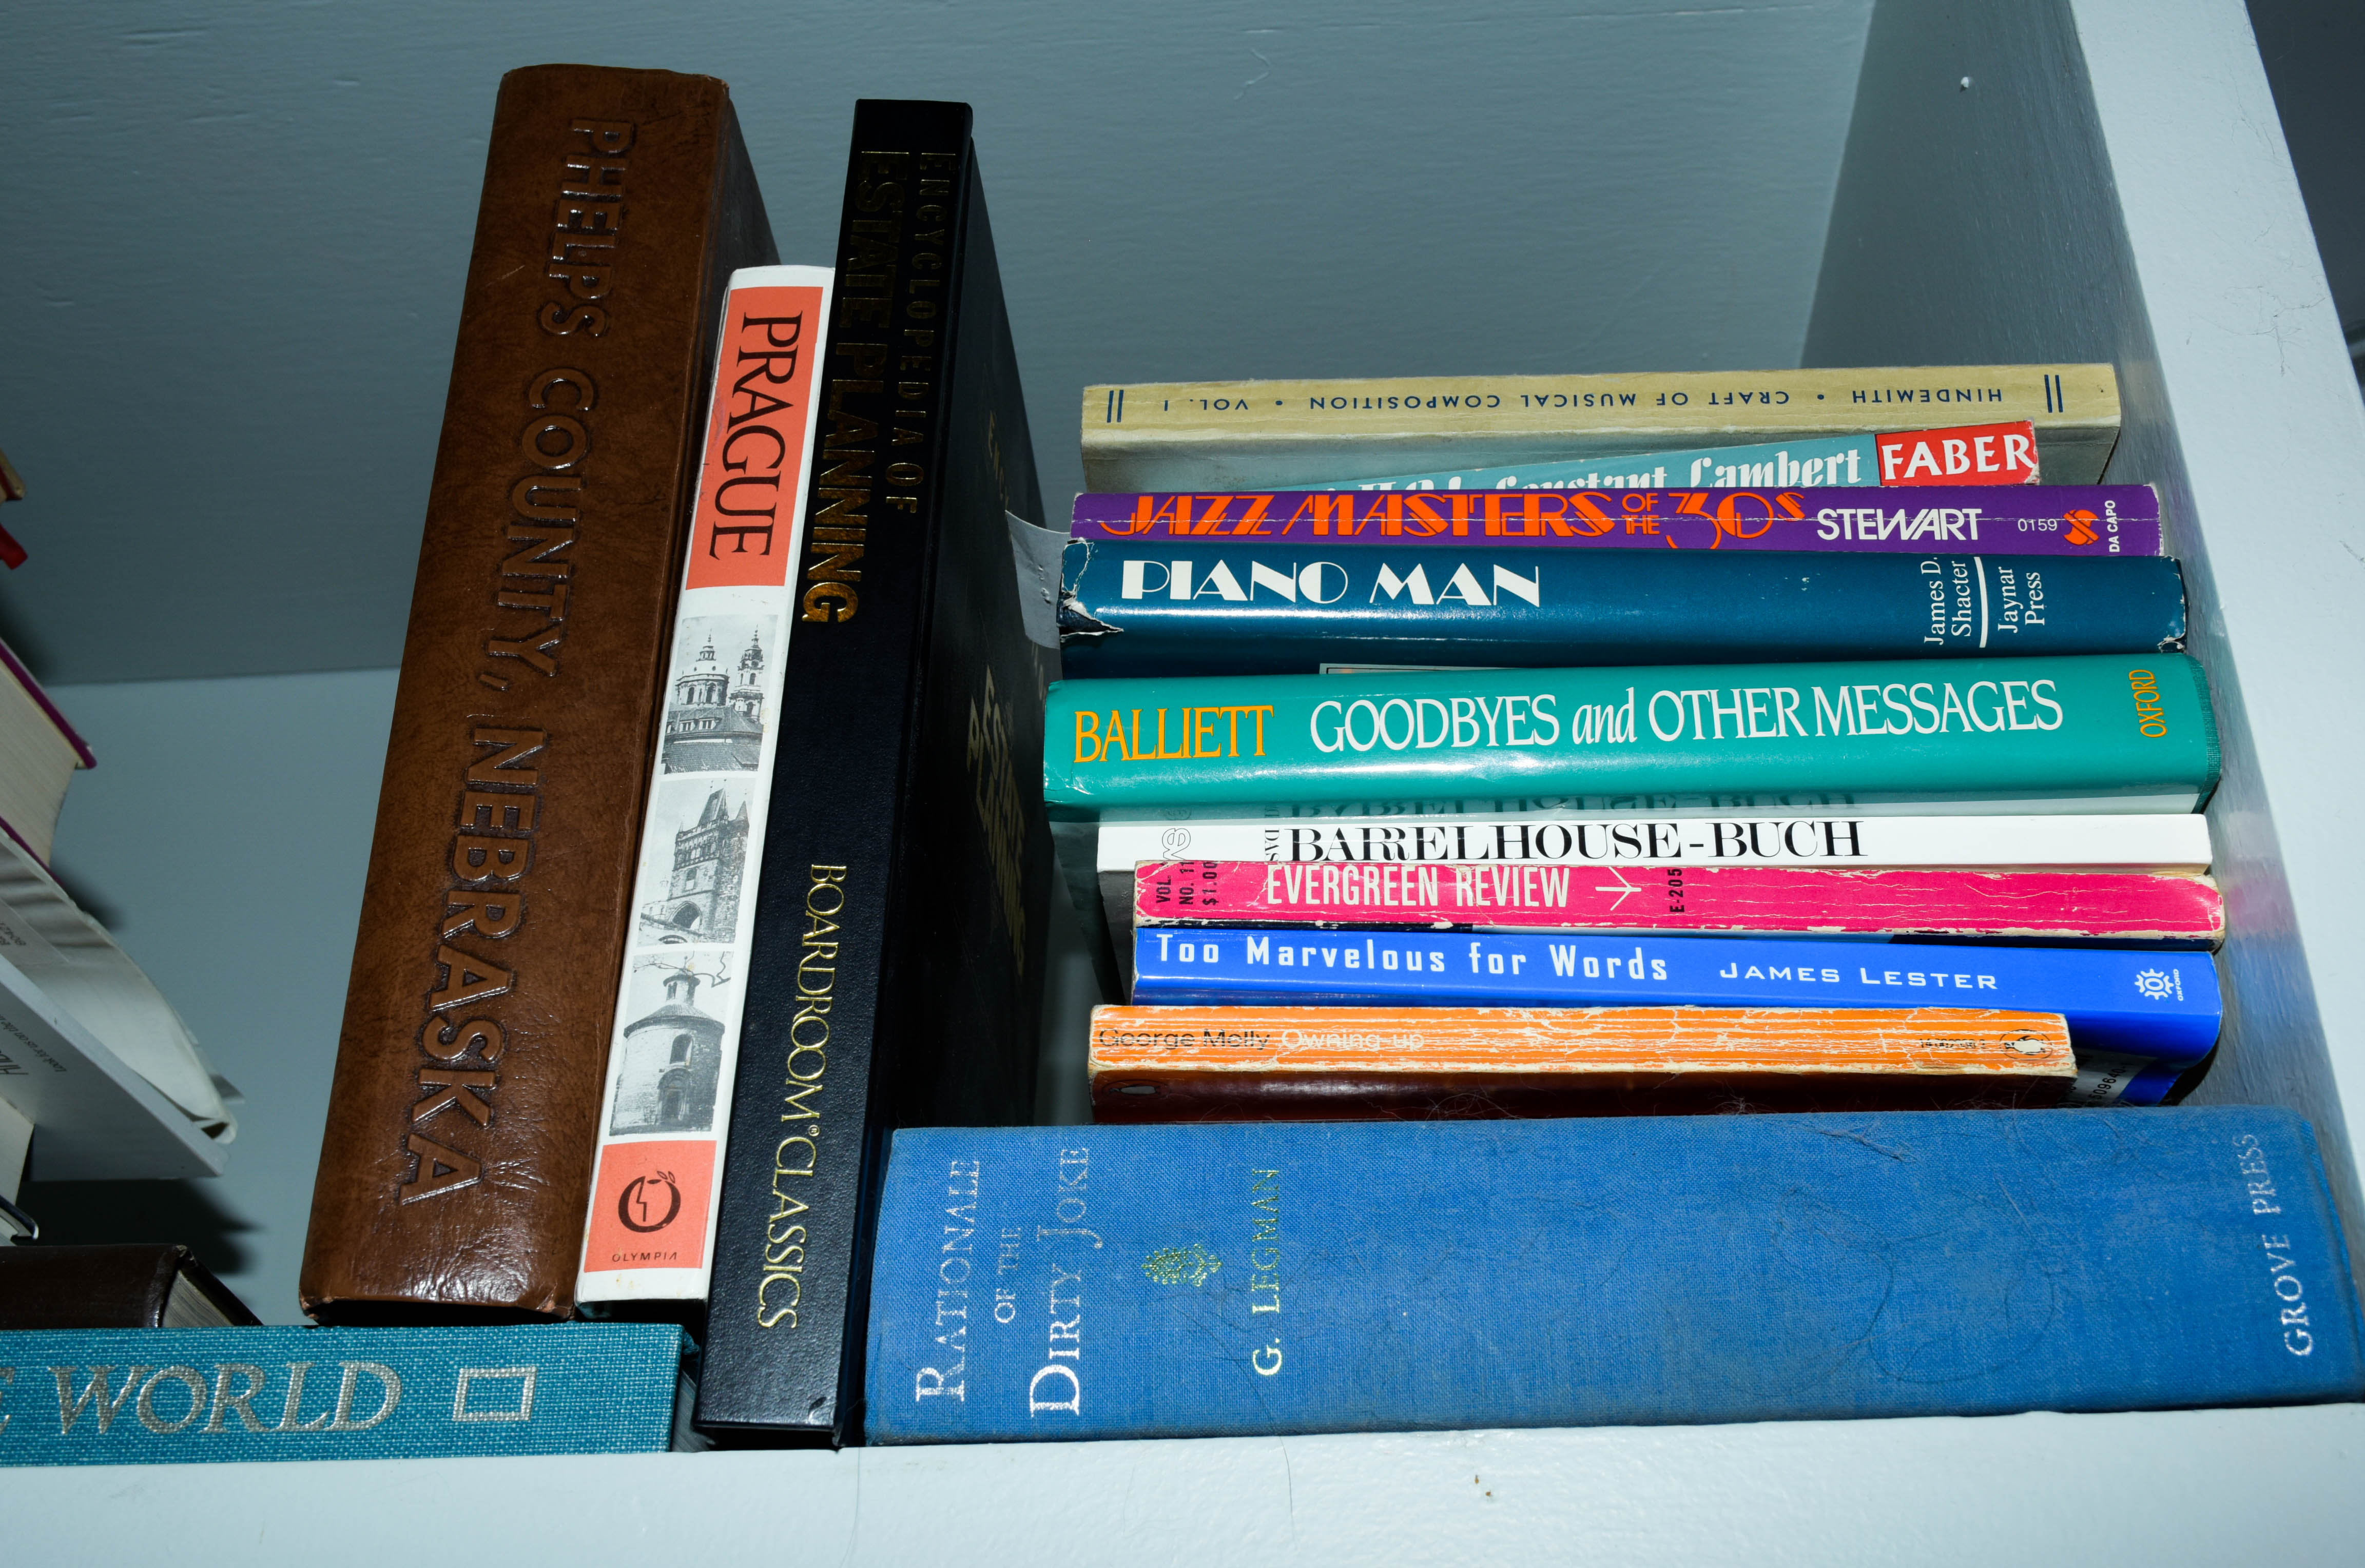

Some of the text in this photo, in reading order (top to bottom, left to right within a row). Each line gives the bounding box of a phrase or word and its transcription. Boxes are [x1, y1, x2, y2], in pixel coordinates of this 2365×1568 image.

[885, 152, 956, 513] ENCYCLOPEDIA OF
[802, 151, 910, 622] ESTATE PLANNING
[1190, 397, 1248, 410] VOL.
[1310, 395, 1500, 410] COMPOSITION
[1521, 394, 1636, 408] MUSICAL
[1656, 392, 1688, 406] OF
[1709, 391, 1789, 405] CRAFT
[1852, 388, 2002, 403] HINDEMITH
[709, 310, 803, 561] PRAGUE
[1882, 434, 2038, 480] FABER
[1691, 449, 1862, 488] Lambert
[1100, 495, 1275, 535] JAZZ
[1282, 492, 1615, 537] MASTERS
[1621, 515, 1660, 534] THE
[1622, 493, 1658, 512] OF
[1817, 508, 1982, 540] STEWART
[2018, 518, 2058, 532] 0159
[2104, 500, 2120, 552] DA CAPO
[1121, 560, 1540, 607] PIANO MAN
[1921, 557, 1945, 645] James D.
[1951, 561, 1971, 637] Shacter
[1998, 566, 2024, 634] Jaynar
[2025, 572, 2045, 626] Press
[400, 119, 635, 1206] PHELPS COUNTY, NEBRASKA
[1310, 679, 2063, 753] GOODBYES and OTHER MESSAGES
[2129, 669, 2168, 738] OXFORD
[1074, 704, 1274, 763] BALLIETT
[1265, 828, 1280, 861] DAS
[1285, 820, 1868, 861] BARRELHOUSE-BUCH
[1156, 875, 1171, 903] VOL.
[1179, 883, 1194, 905] NO.
[1203, 862, 1219, 905] $1.00
[1267, 865, 1569, 908] EVERGREEN REVIEW
[1668, 868, 1684, 912] E-205
[1156, 933, 1667, 981] Too Marvelous for Words
[1720, 962, 1998, 990] JAMES LESTER
[2173, 968, 2184, 1002] OXFORD
[1099, 1028, 1271, 1050] George Melly
[758, 1135, 817, 1328] CLASSICS
[2233, 1134, 2314, 1356] GROVE PRESS
[611, 1251, 677, 1263] OLYMPIA
[994, 1227, 1021, 1324] OF THE
[1251, 1168, 1283, 1376] G. LEGMAN
[916, 1160, 980, 1402] RATIONALE
[1030, 1147, 1103, 1418] DIRTY JOKE
[47, 1361, 403, 1435] WORLD
